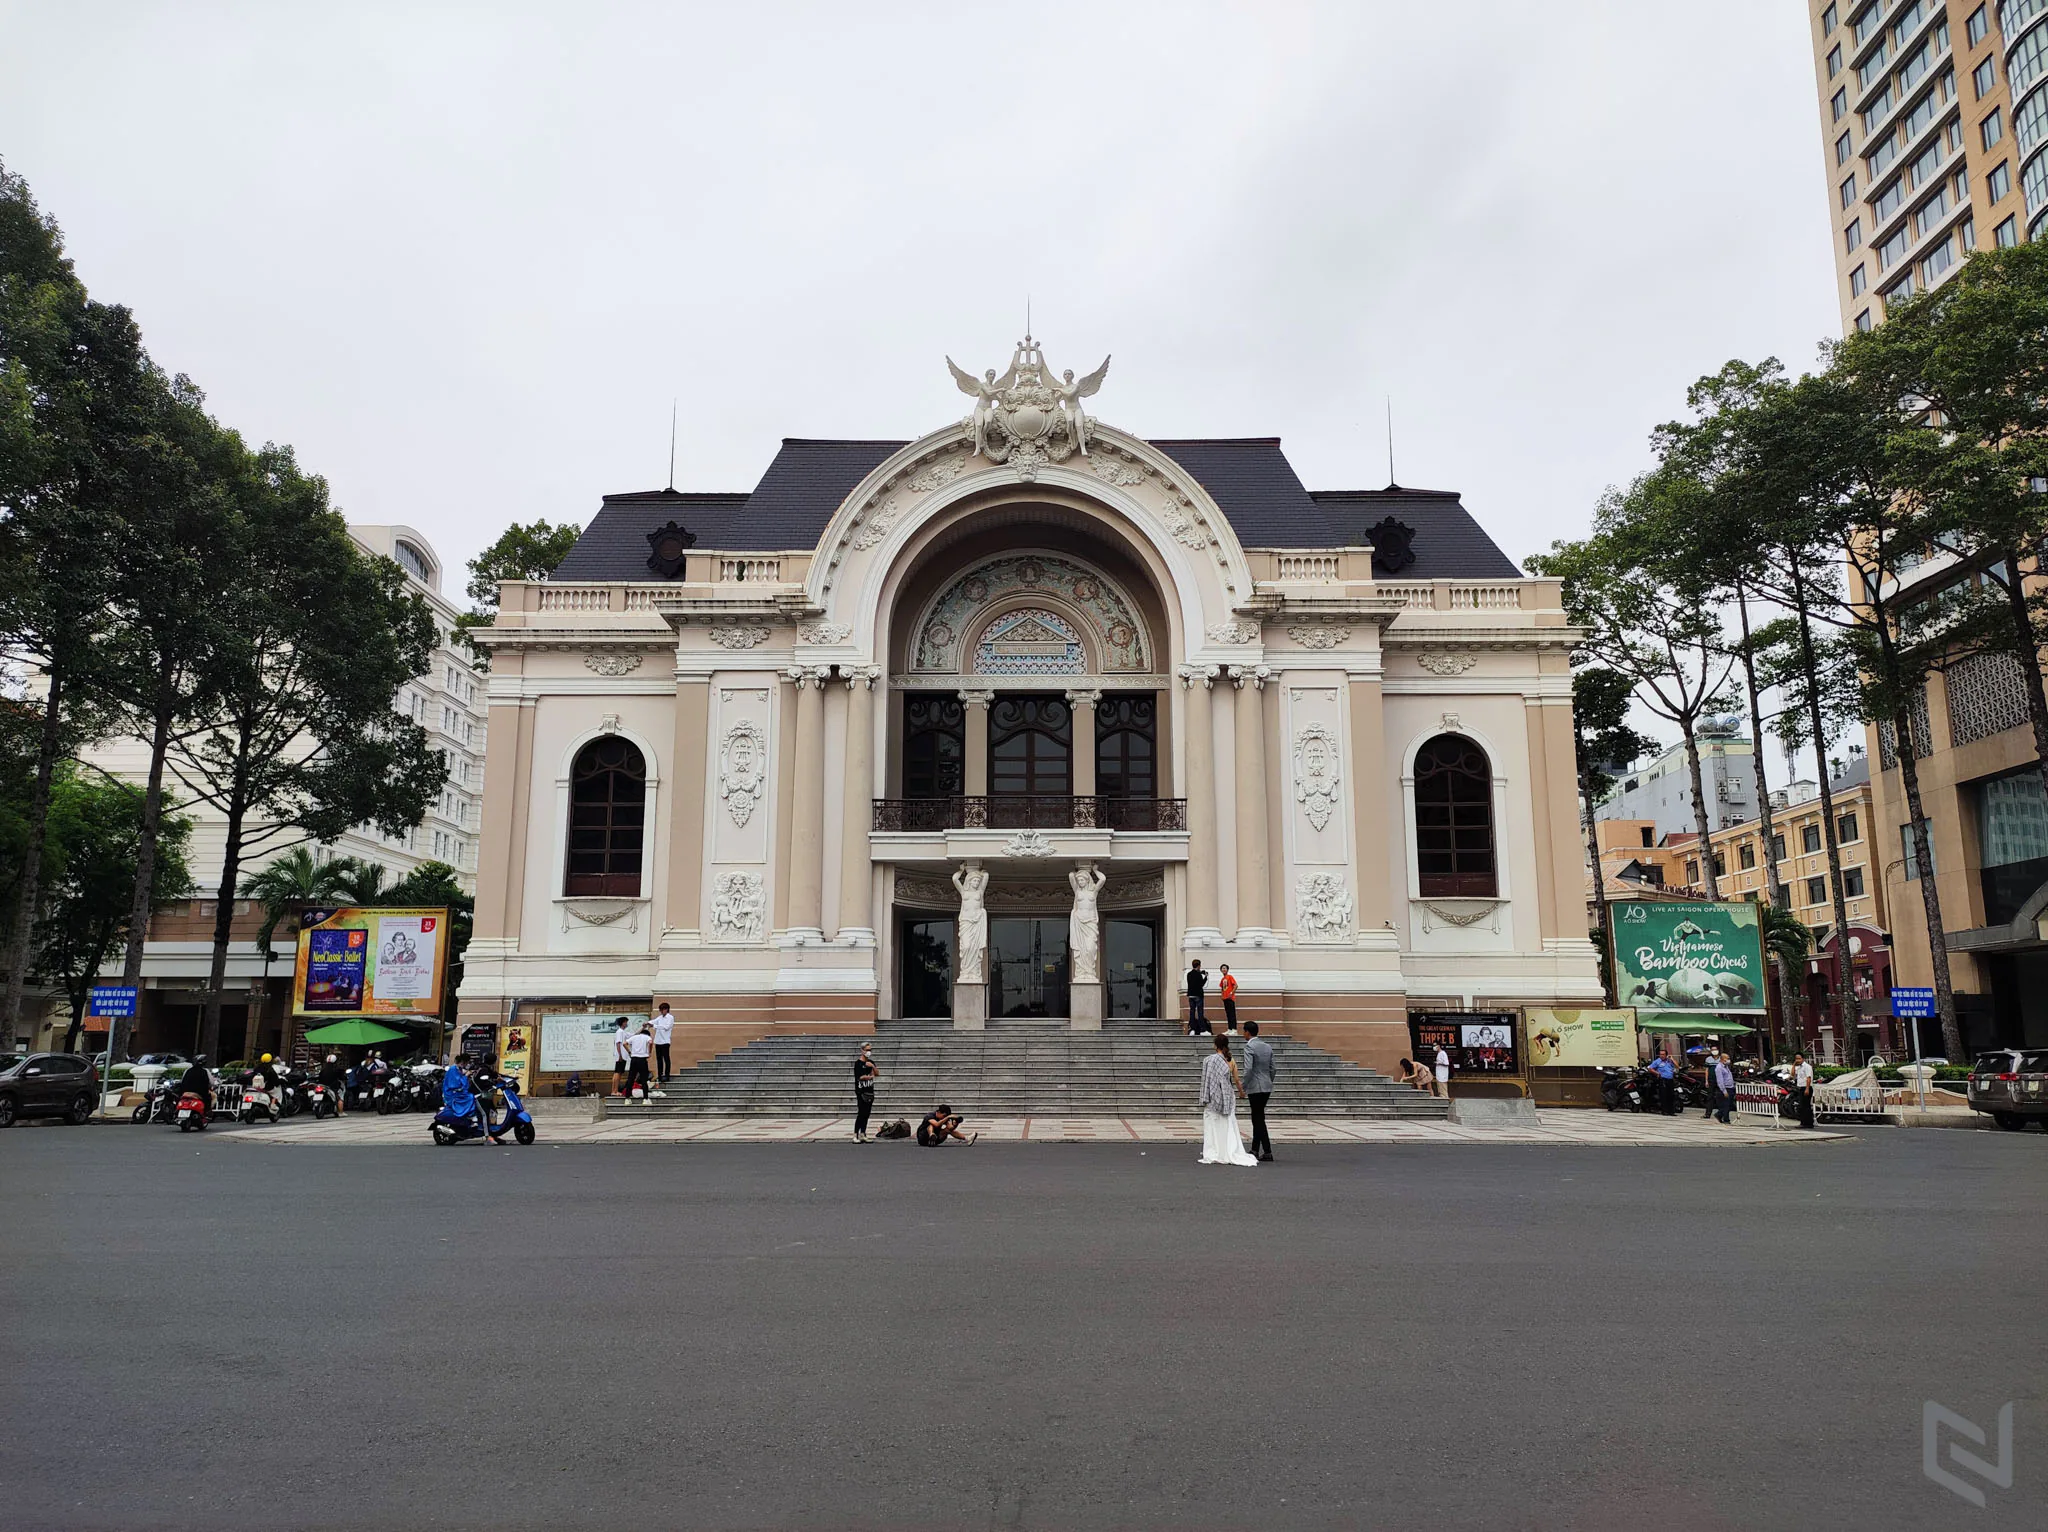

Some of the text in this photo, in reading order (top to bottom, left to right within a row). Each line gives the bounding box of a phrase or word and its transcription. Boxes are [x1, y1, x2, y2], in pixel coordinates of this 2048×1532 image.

[1660, 937, 1724, 954] Vietnamese
[344, 951, 362, 963] Ballet
[1635, 946, 1748, 970] Bamboo Circus
[1563, 1024, 1584, 1032] SHOW
